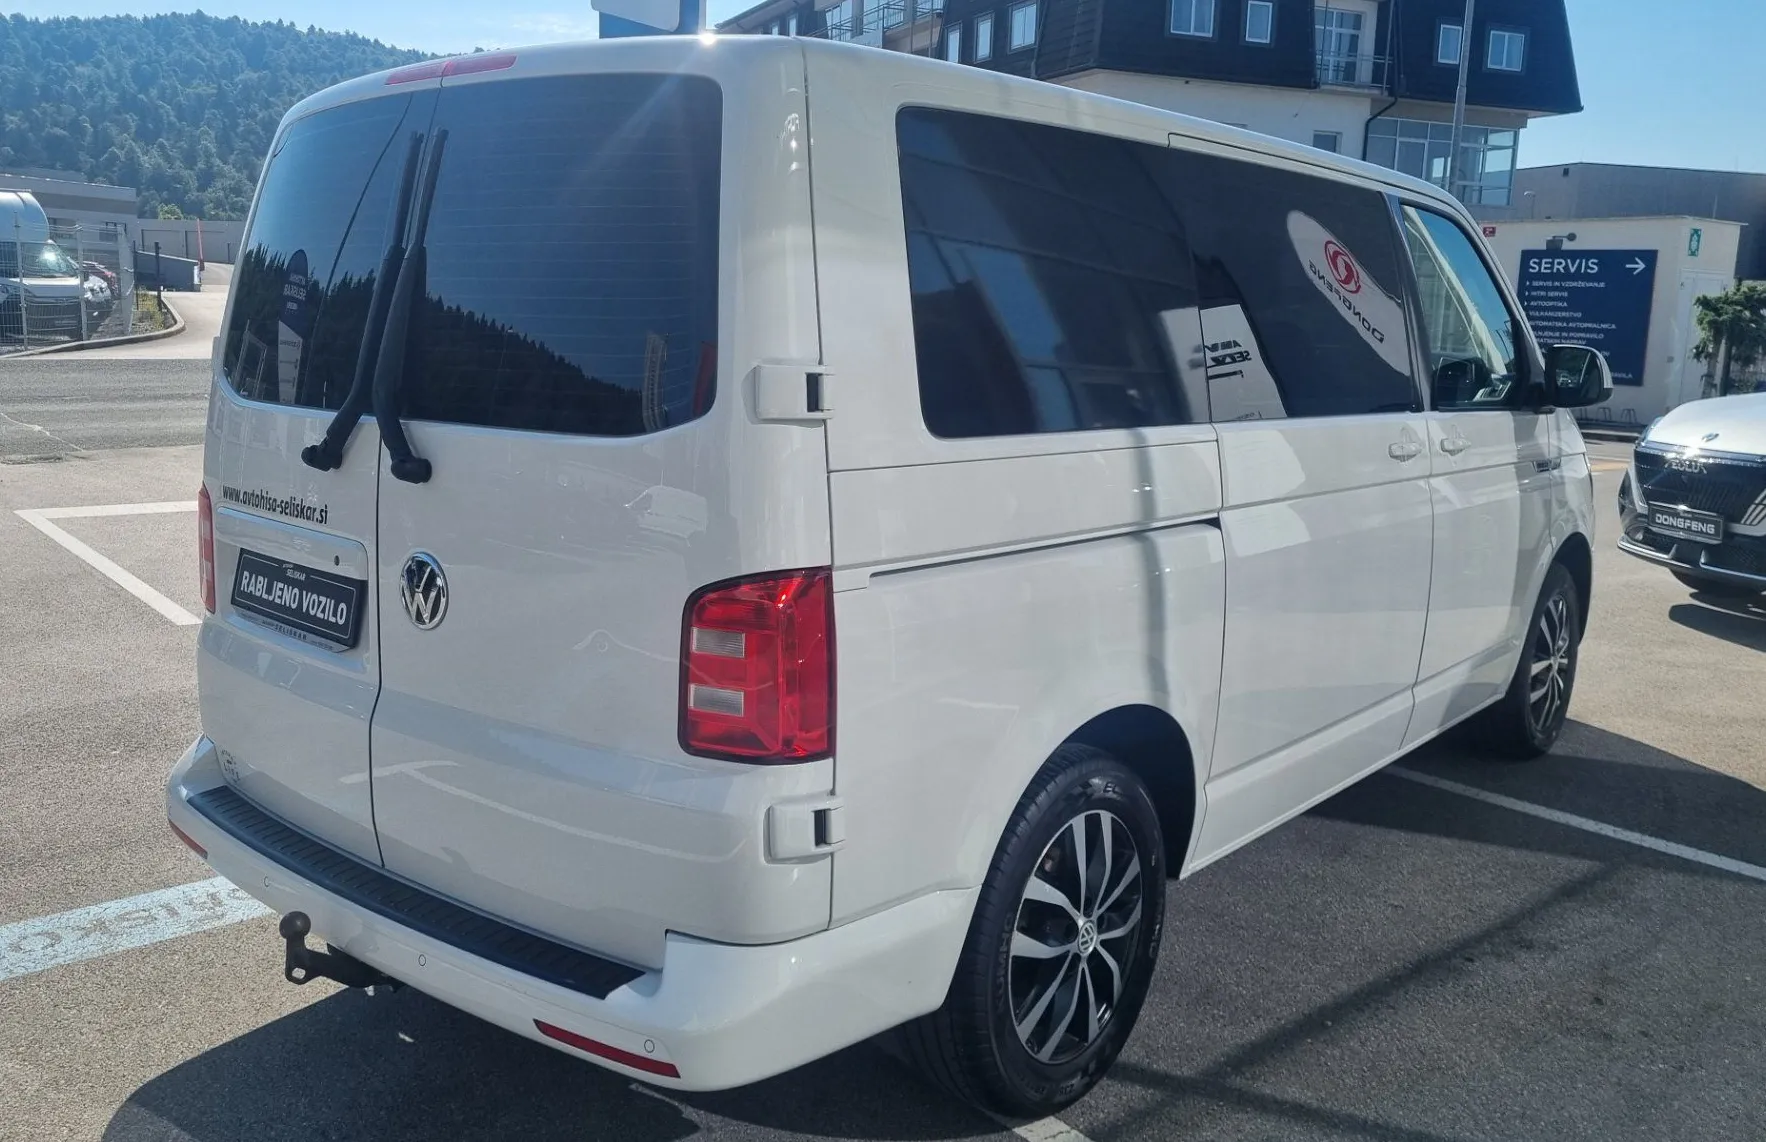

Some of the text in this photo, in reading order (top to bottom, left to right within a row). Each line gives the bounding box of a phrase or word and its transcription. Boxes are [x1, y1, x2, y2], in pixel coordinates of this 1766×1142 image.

[1528, 258, 1599, 274] SERVIS
[223, 484, 328, 525] www.avtohisa-seliskar.si
[1655, 513, 1715, 535] DONGFENG
[240, 570, 347, 625] RABLJENO VOZILO
